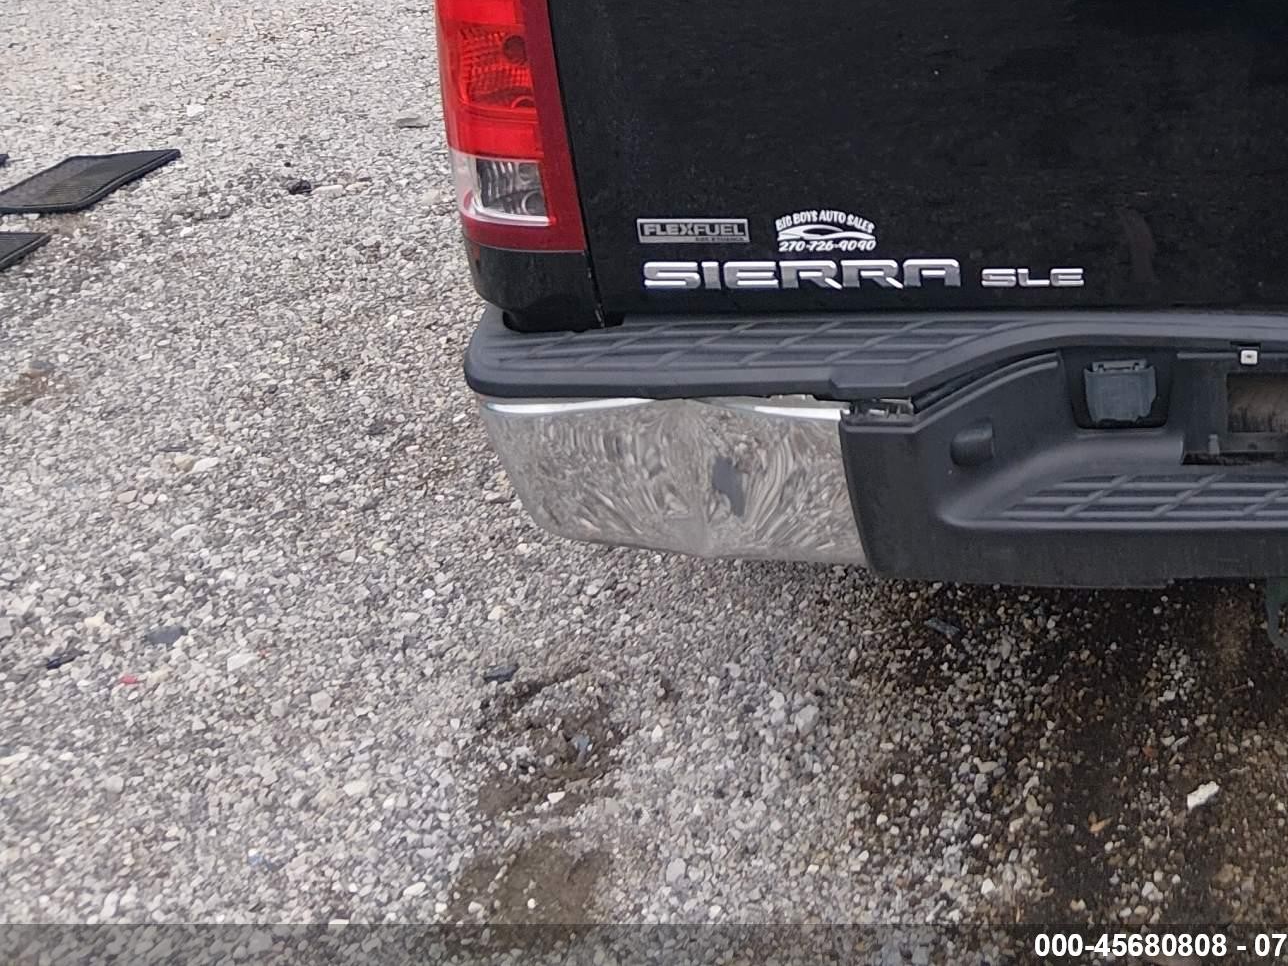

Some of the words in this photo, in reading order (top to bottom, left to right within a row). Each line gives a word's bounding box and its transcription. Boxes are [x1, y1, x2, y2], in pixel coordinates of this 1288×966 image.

[643, 223, 745, 236] FLEXFUEL
[775, 215, 793, 232] BIG
[793, 210, 818, 225] BOYS
[819, 209, 847, 224] AUTO
[846, 214, 875, 234] SALES
[642, 259, 962, 291] SIERRA
[981, 267, 1085, 288] SLE
